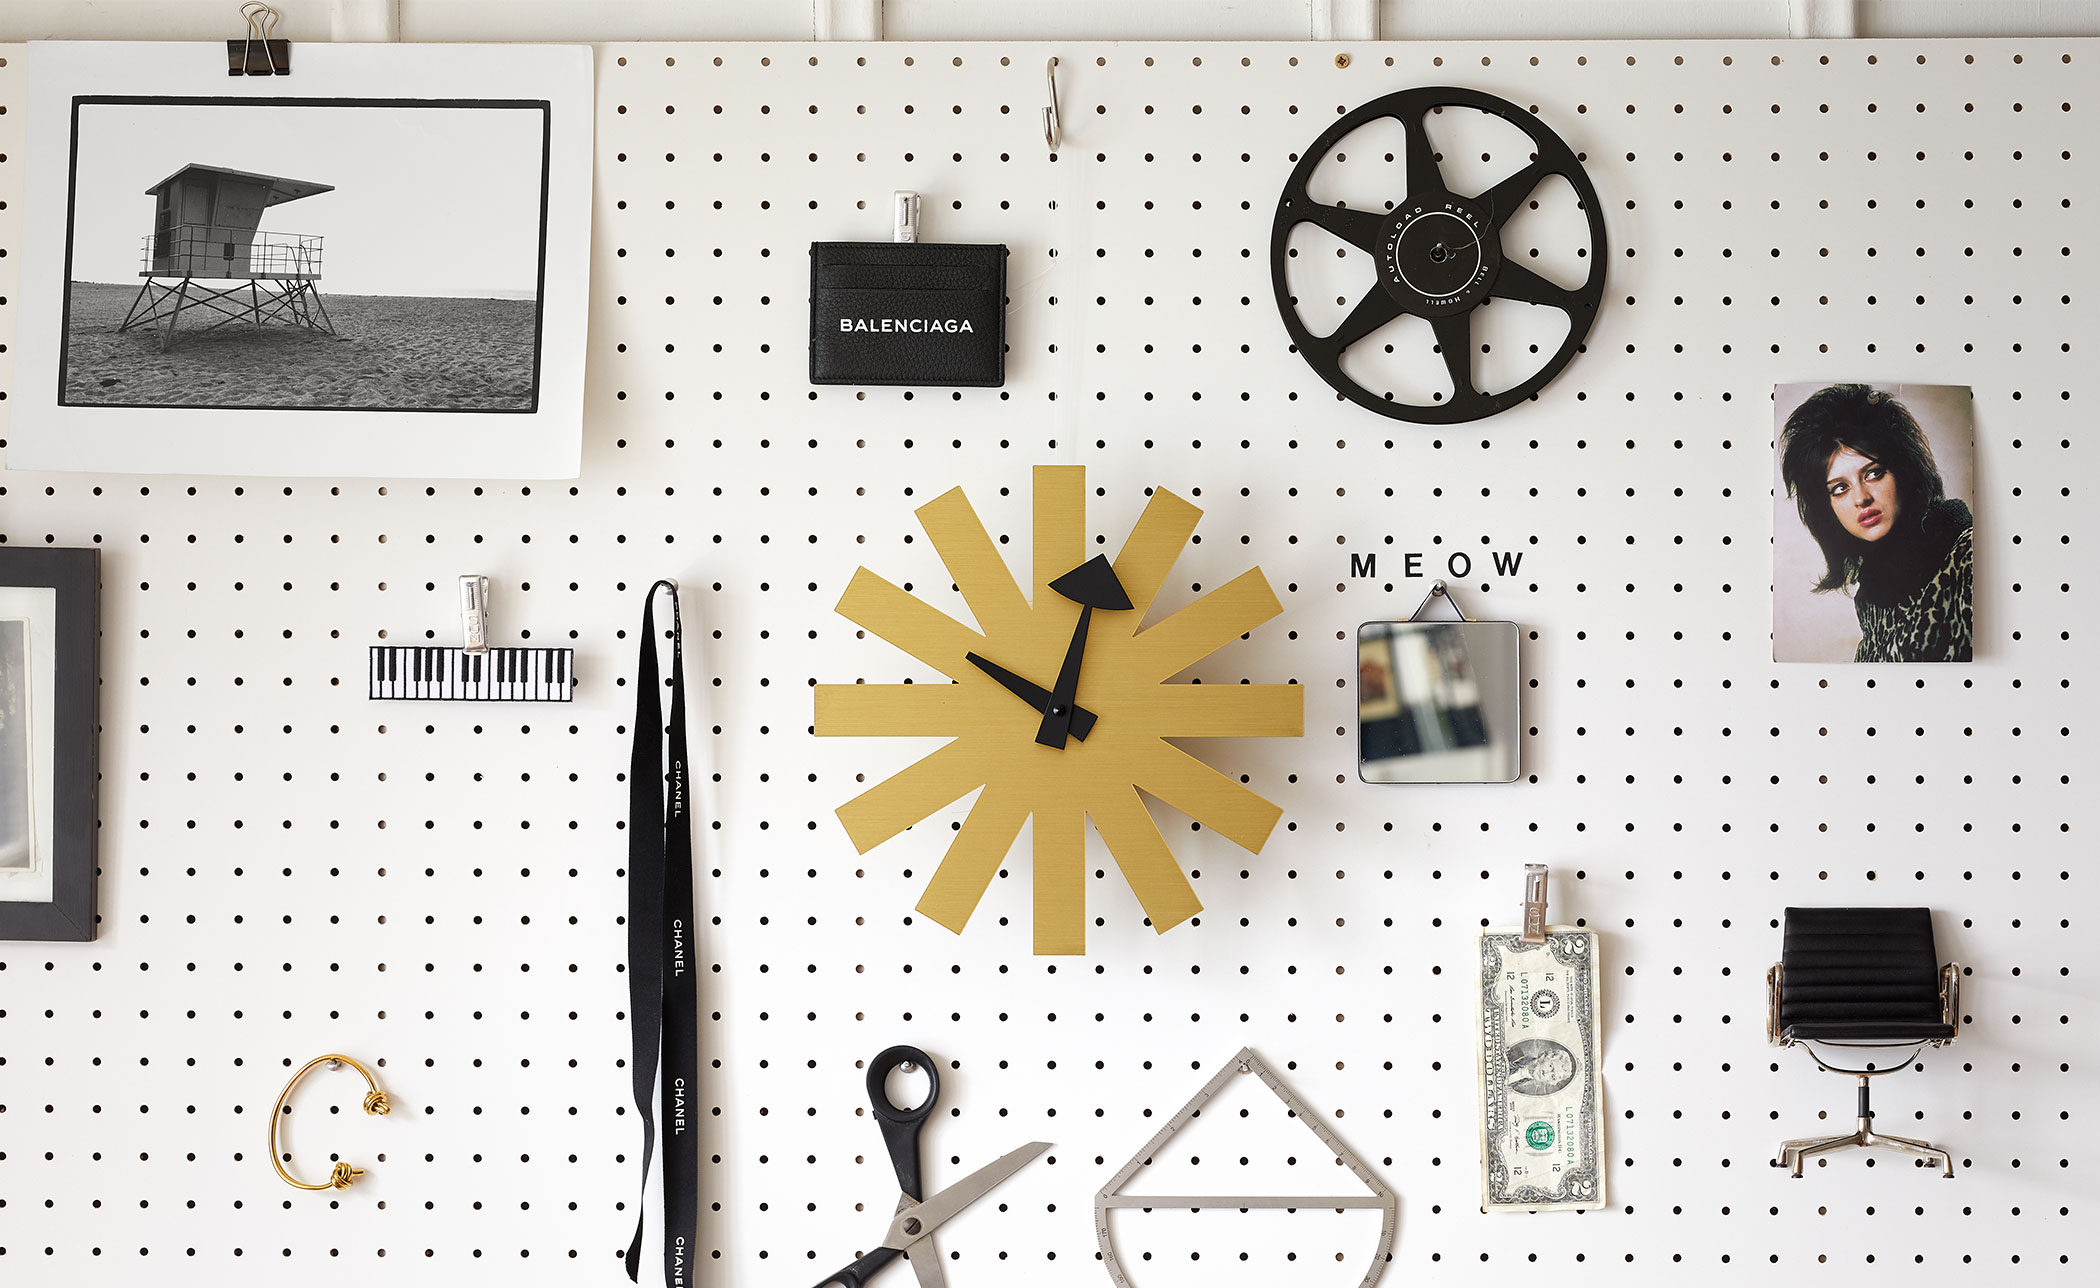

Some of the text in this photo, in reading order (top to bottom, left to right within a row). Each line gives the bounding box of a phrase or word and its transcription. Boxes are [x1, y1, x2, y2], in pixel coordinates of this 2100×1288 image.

[1386, 203, 1480, 283] AUTOLOAD REEL
[1426, 296, 1460, 306] HOWELL
[841, 319, 973, 333] BALENCIAGA
[674, 761, 682, 818] CHANEL
[674, 920, 684, 976] CHANEL
[1563, 939, 1585, 955] 2
[1507, 972, 1514, 980] 12
[1546, 972, 1554, 981] 12
[1540, 1000, 1550, 1008] L
[675, 1078, 684, 1135] CHANEL
[1514, 1167, 1522, 1175] 12
[1552, 1163, 1560, 1172] 12
[1571, 1180, 1591, 1196] 2
[674, 1236, 685, 1288] CHANE
